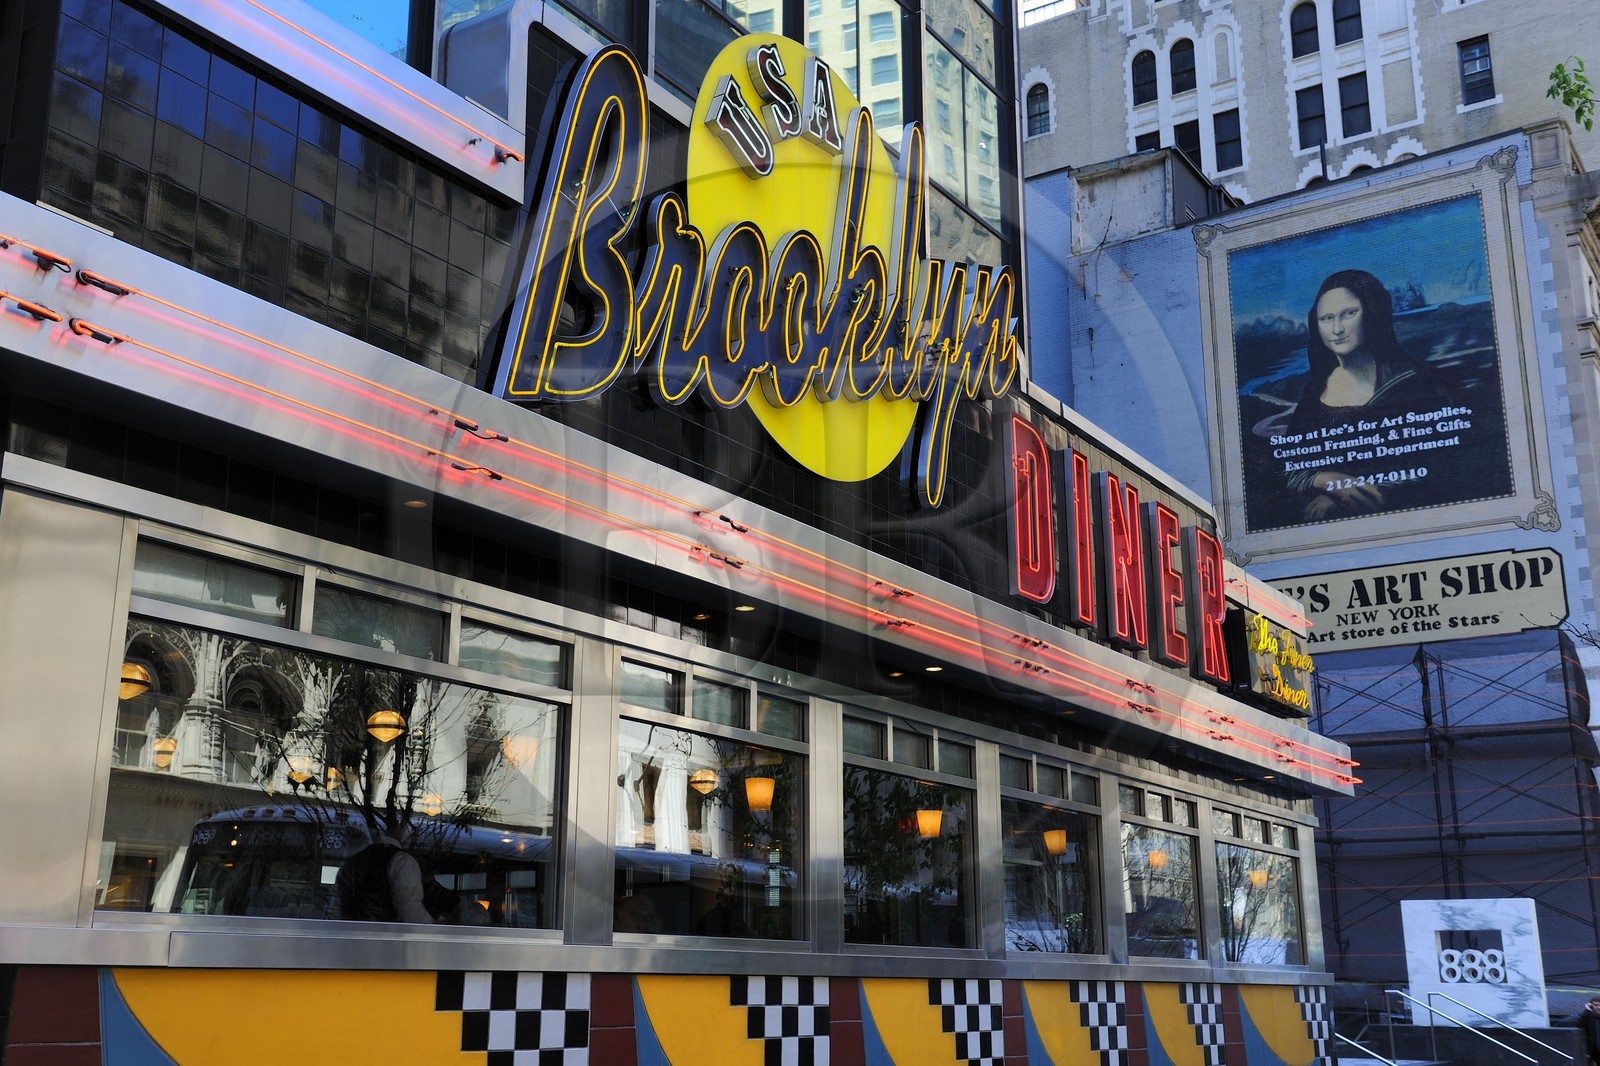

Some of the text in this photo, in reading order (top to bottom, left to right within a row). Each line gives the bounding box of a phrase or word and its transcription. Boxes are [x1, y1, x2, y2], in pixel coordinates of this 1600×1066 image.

[706, 43, 842, 178] USA
[496, 44, 1018, 508] Brooklyn
[1270, 405, 1472, 446] Shop at Lee's for Art Supplies,
[1273, 418, 1471, 459] Custom Framing, & Fine Gifts
[1284, 436, 1459, 472] Extensive Pen Department
[1326, 467, 1428, 492] 212-247-0110
[1008, 411, 1231, 685] DINER
[1347, 571, 1428, 609] ART
[1440, 556, 1554, 599] SHOP
[1252, 613, 1278, 655] The
[1307, 630, 1336, 644] Art
[1341, 624, 1385, 640] store
[1391, 621, 1409, 635] of
[1412, 617, 1442, 633] the
[1336, 603, 1440, 626] NEW YORK
[1271, 664, 1308, 709] Diner
[1440, 949, 1505, 984] 888
